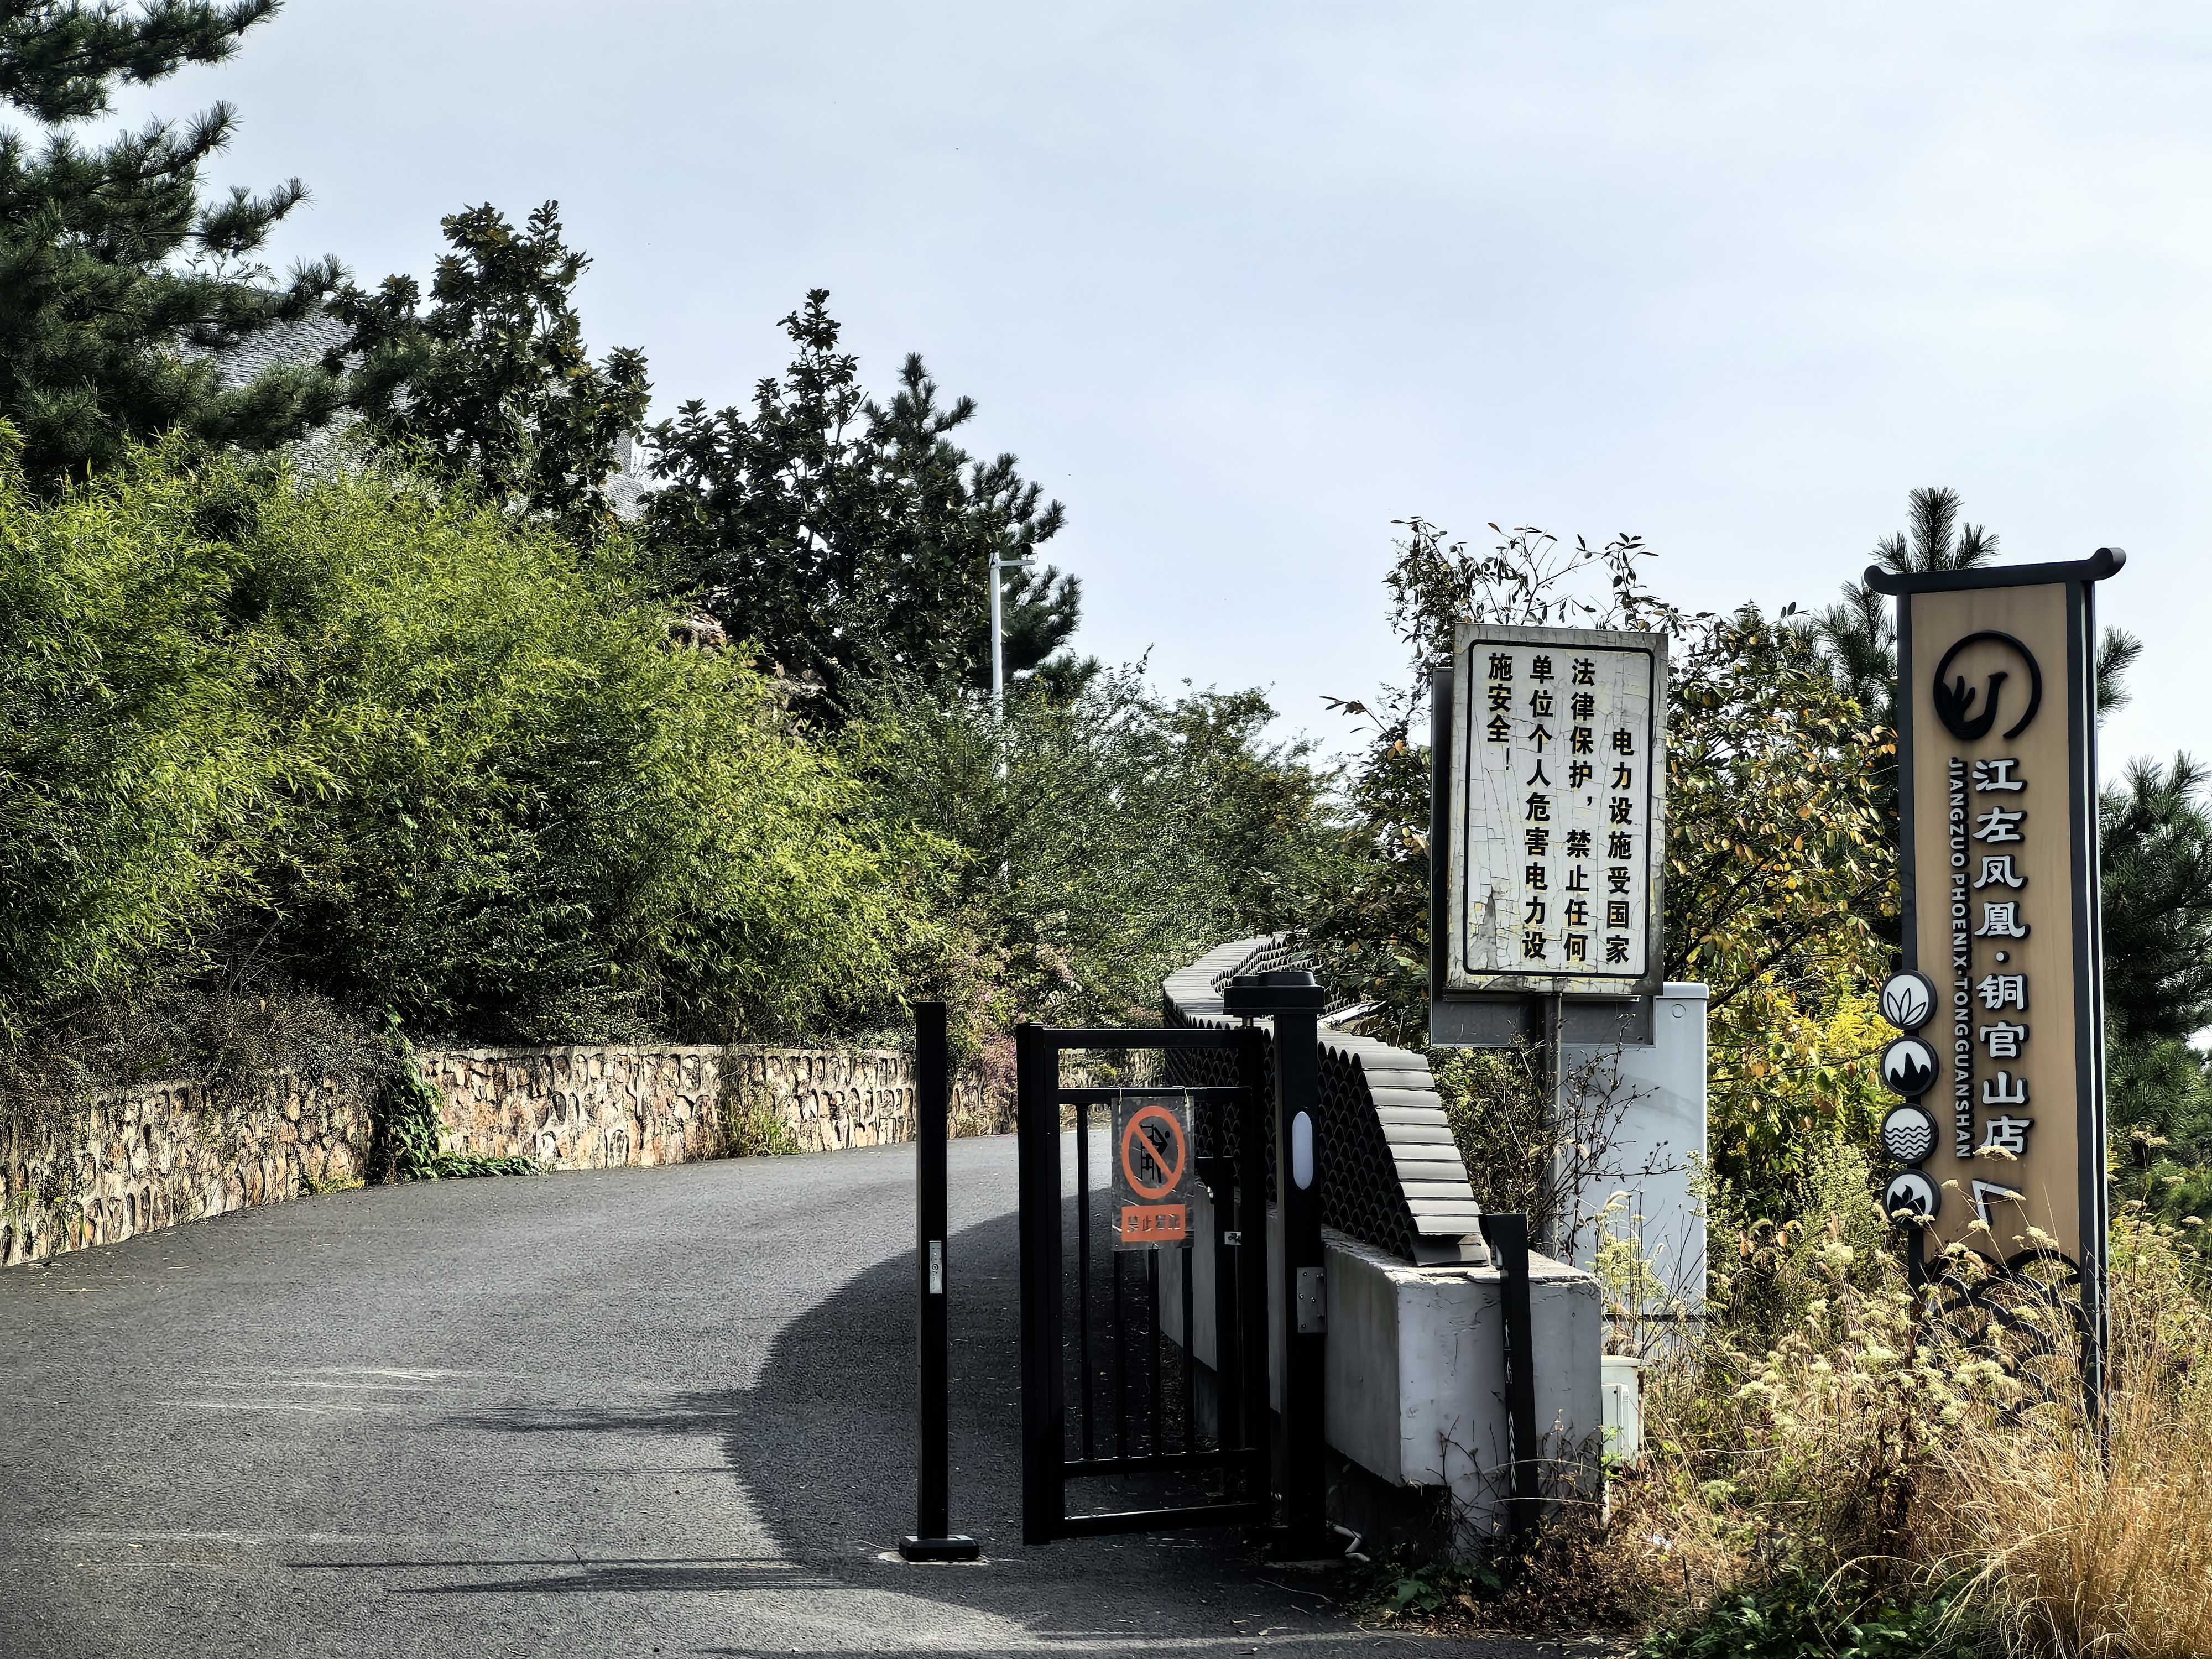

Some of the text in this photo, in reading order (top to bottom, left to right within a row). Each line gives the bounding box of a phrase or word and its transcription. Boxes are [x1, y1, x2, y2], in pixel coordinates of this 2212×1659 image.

[1486, 652, 1513, 771] 施安全！
[1522, 654, 1554, 961] 单位个人危害电力设
[1605, 727, 1634, 964] 电力设施受国家
[1948, 758, 1967, 868] JIANGZUO
